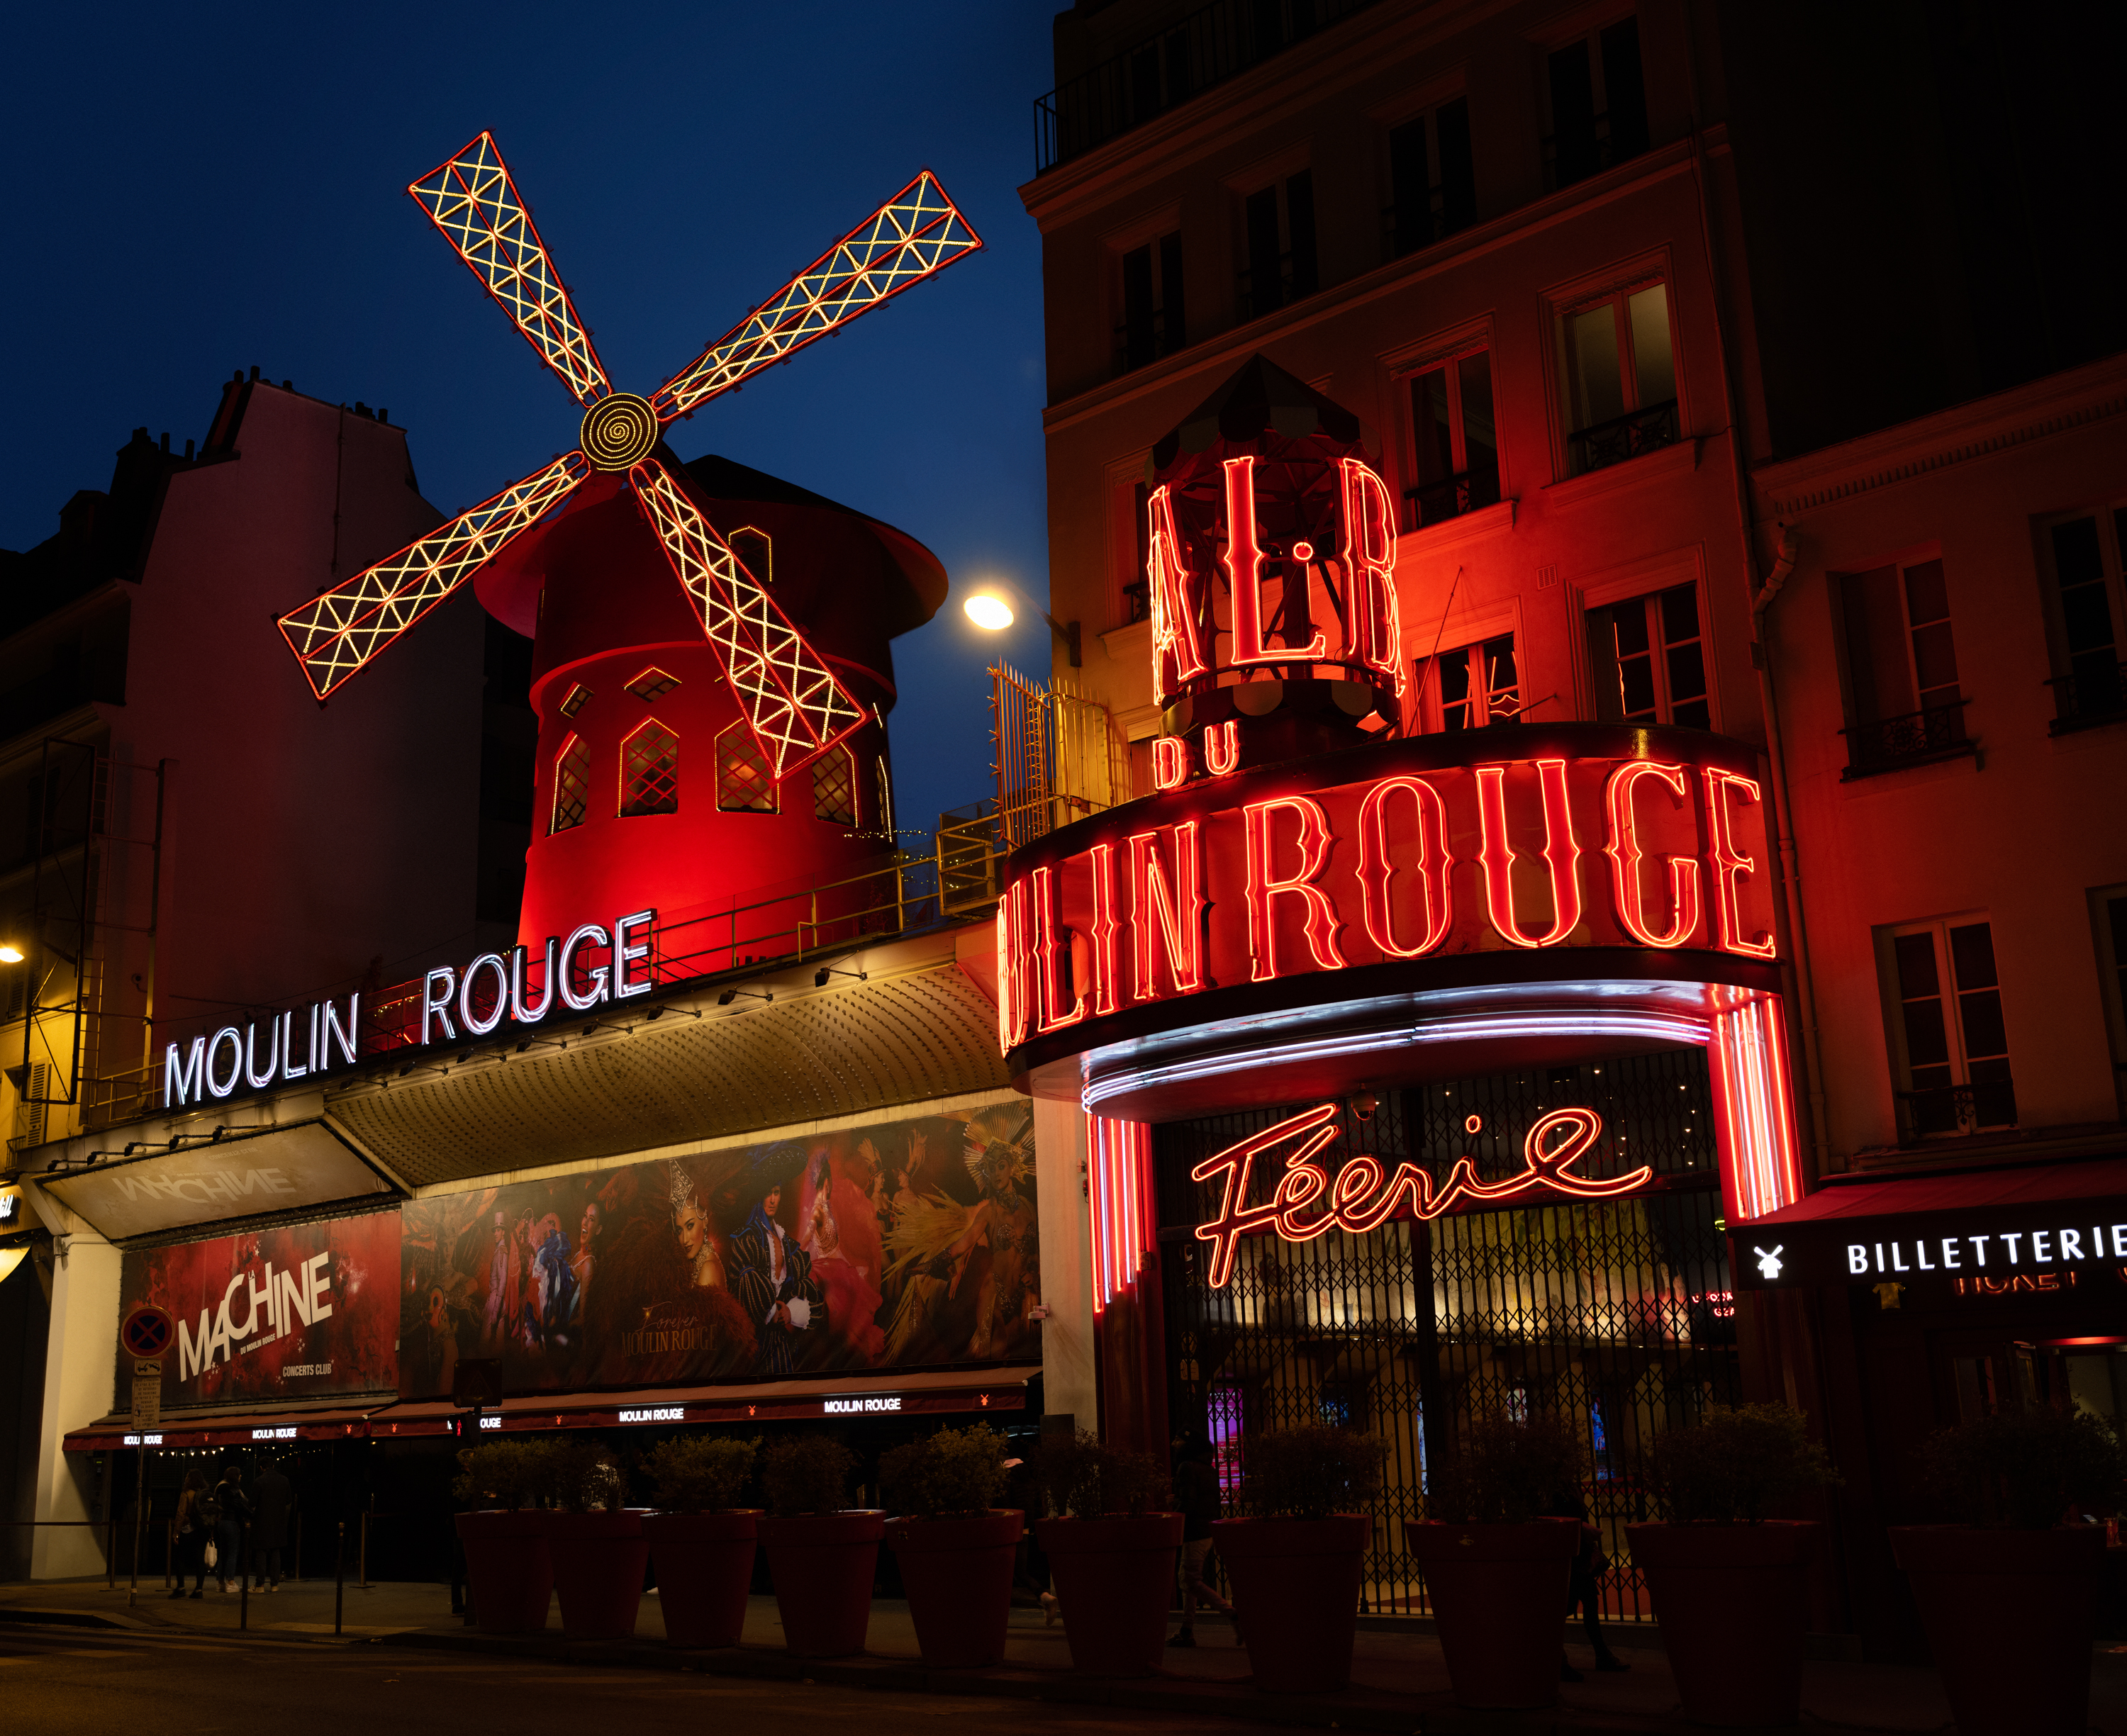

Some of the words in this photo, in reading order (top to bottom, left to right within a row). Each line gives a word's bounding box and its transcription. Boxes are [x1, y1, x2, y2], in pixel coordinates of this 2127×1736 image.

[1152, 720, 1240, 790] DU
[1243, 756, 1777, 982] ROUGE
[163, 991, 359, 1109] MOULIN
[420, 907, 658, 1046] ROUGE
[1192, 1103, 1653, 1289] Féerie
[1848, 1223, 2127, 1275] BILLETTERIE
[178, 1250, 333, 1382] MACHINE
[635, 1301, 699, 1332] Forever
[247, 1338, 262, 1353] MOULIN
[262, 1333, 276, 1346] ROUGE
[621, 1331, 669, 1358] MOULIN
[671, 1323, 718, 1351] ROUGE
[283, 1364, 314, 1377] CONCERTS
[315, 1363, 332, 1375] CLUB
[619, 1410, 652, 1422] MOULIN
[653, 1408, 684, 1420] ROUGE
[825, 1399, 863, 1413] MOULIN
[865, 1398, 901, 1411] ROUGE
[252, 1429, 275, 1439] MOULIN
[276, 1428, 296, 1438] ROUGE
[480, 1418, 501, 1428] OUGE
[123, 1435, 140, 1445] MOULI
[144, 1435, 163, 1445] ROUGE
